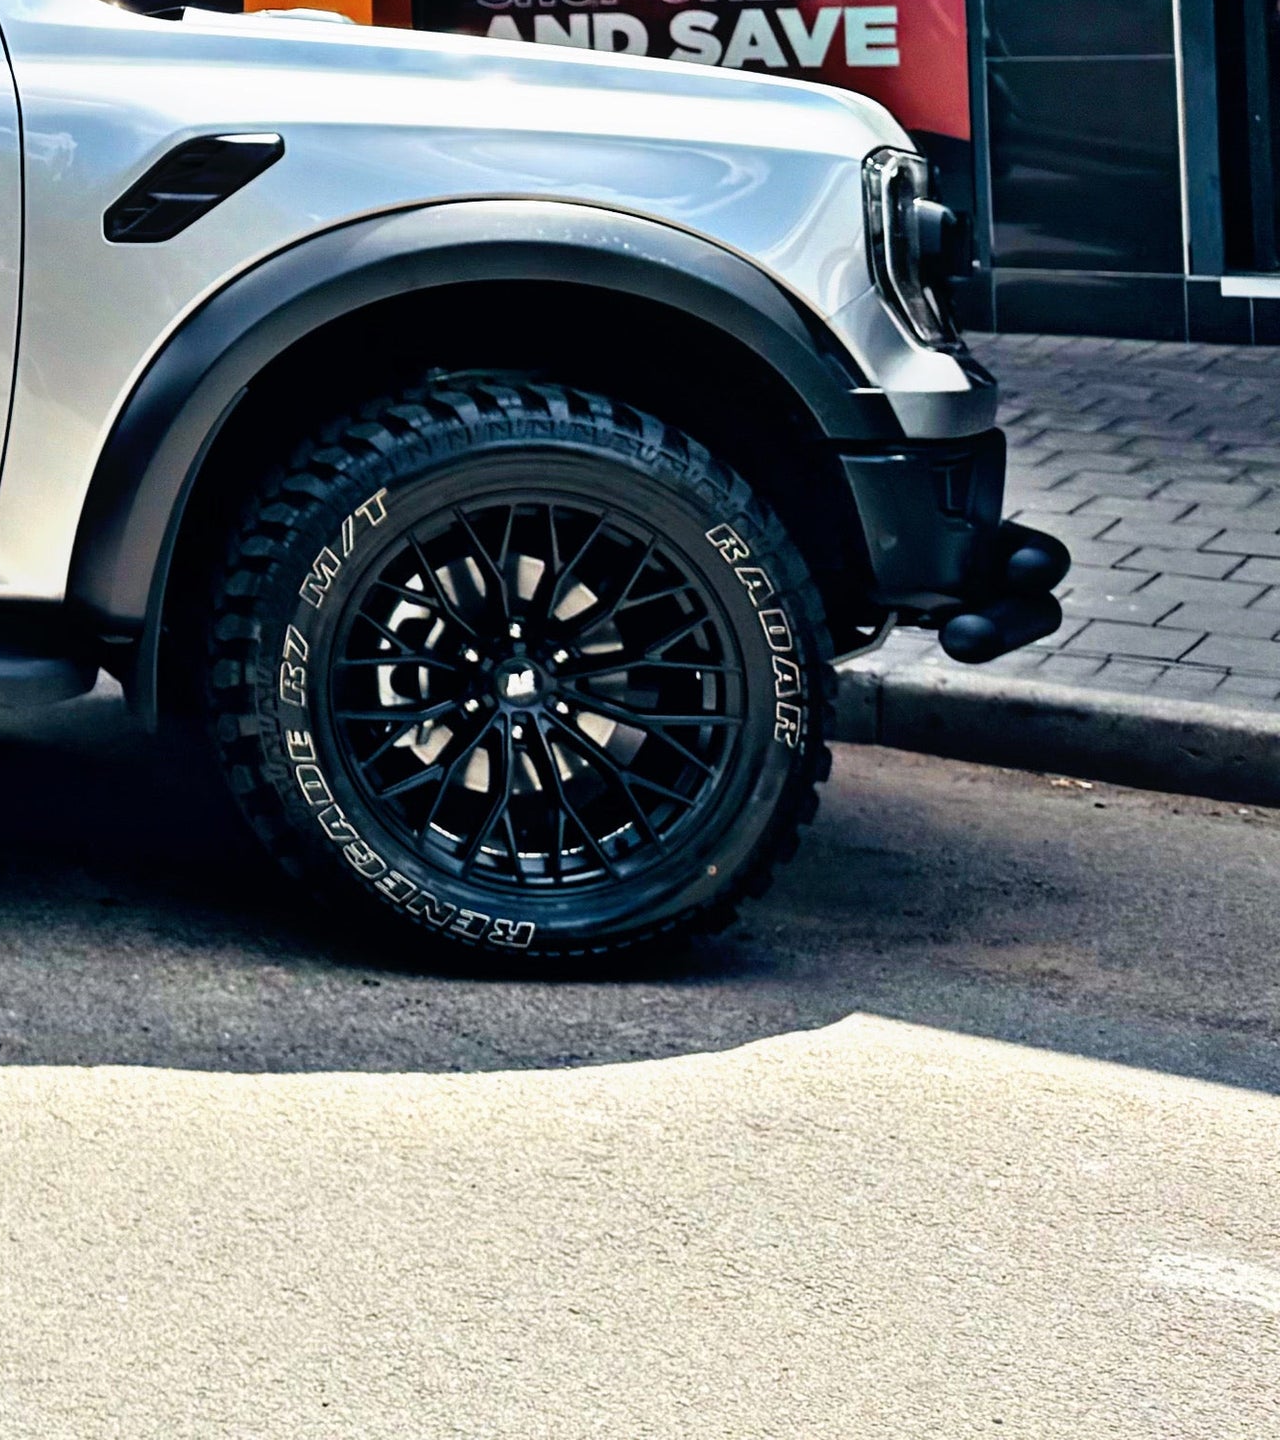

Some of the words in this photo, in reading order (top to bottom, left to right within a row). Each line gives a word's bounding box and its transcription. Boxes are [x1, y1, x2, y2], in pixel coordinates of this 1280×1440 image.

[668, 6, 900, 68] SAVE
[299, 487, 388, 608] M/T
[279, 623, 309, 708] R7
[705, 523, 803, 750] RADAR
[286, 730, 536, 949] RENEGADE
